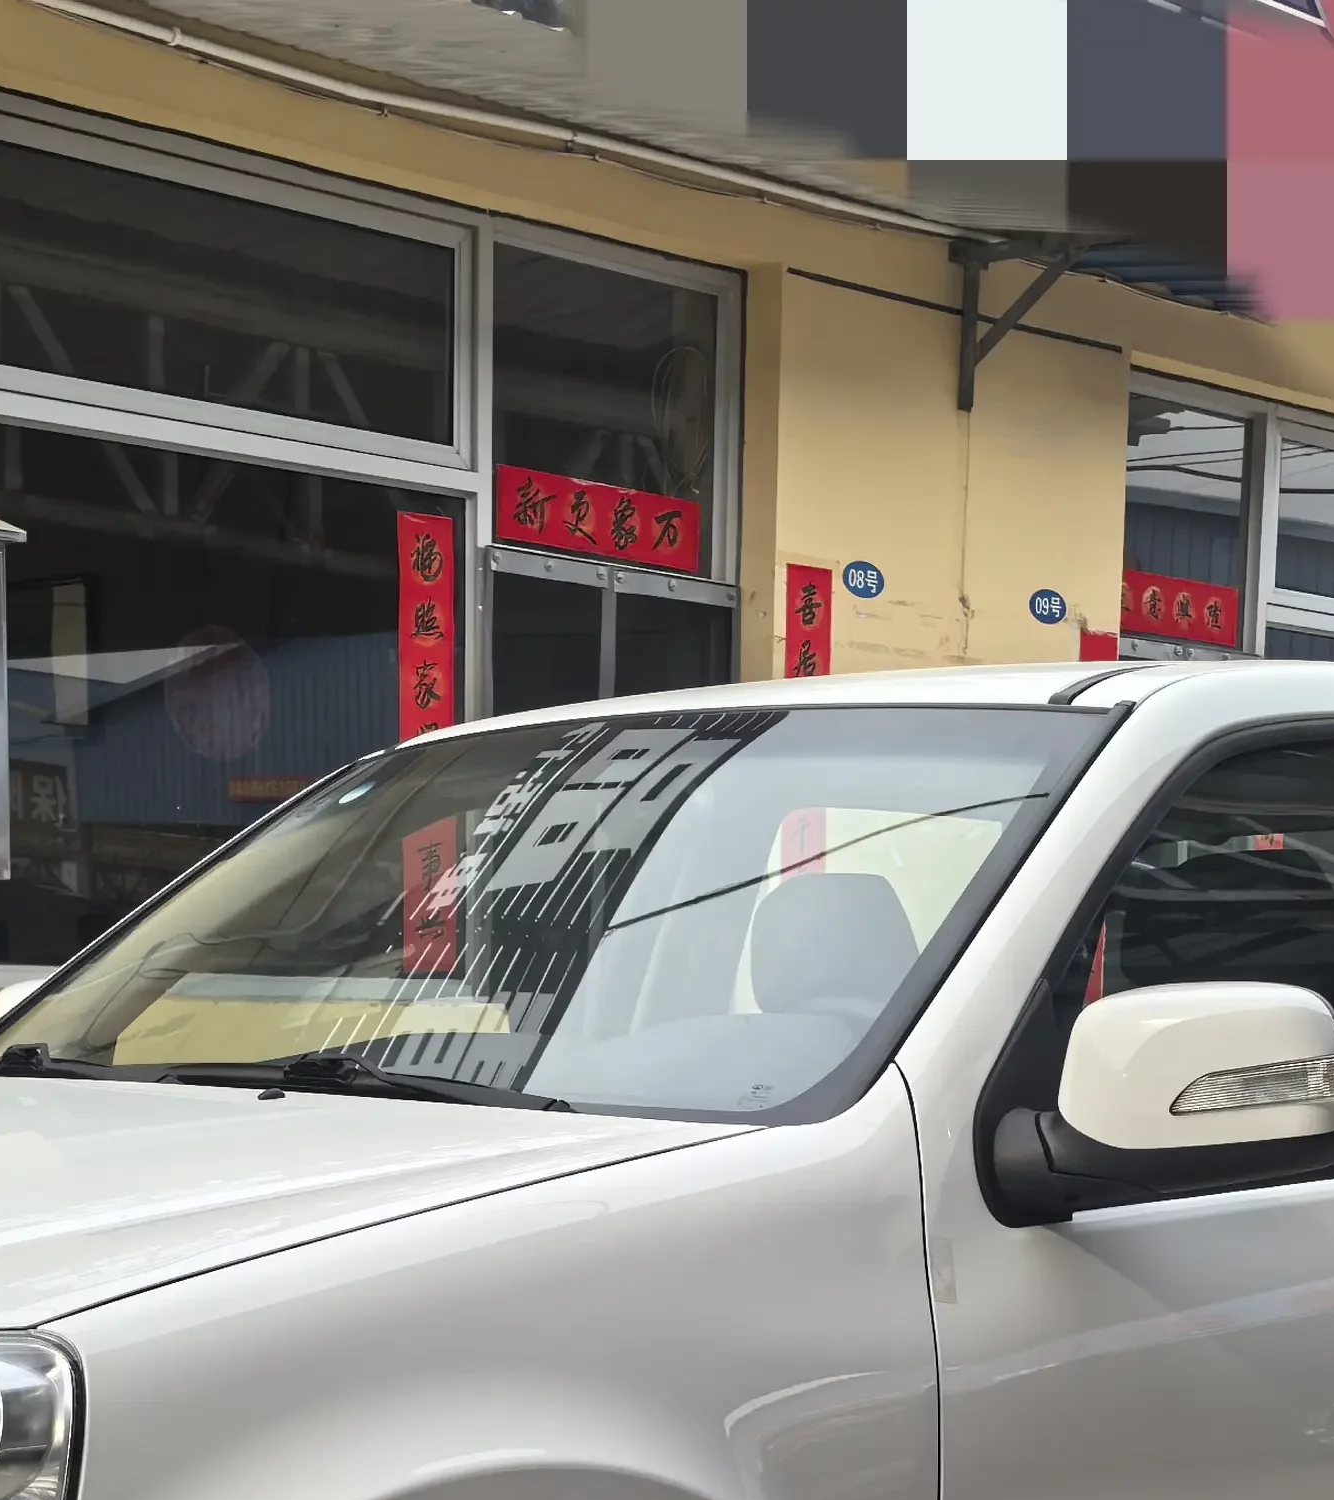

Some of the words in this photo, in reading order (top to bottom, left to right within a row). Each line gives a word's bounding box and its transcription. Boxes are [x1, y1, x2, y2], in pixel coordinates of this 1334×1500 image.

[847, 568, 880, 593] 08号
[1034, 597, 1063, 618] 09号
[410, 533, 445, 737] 福照家
